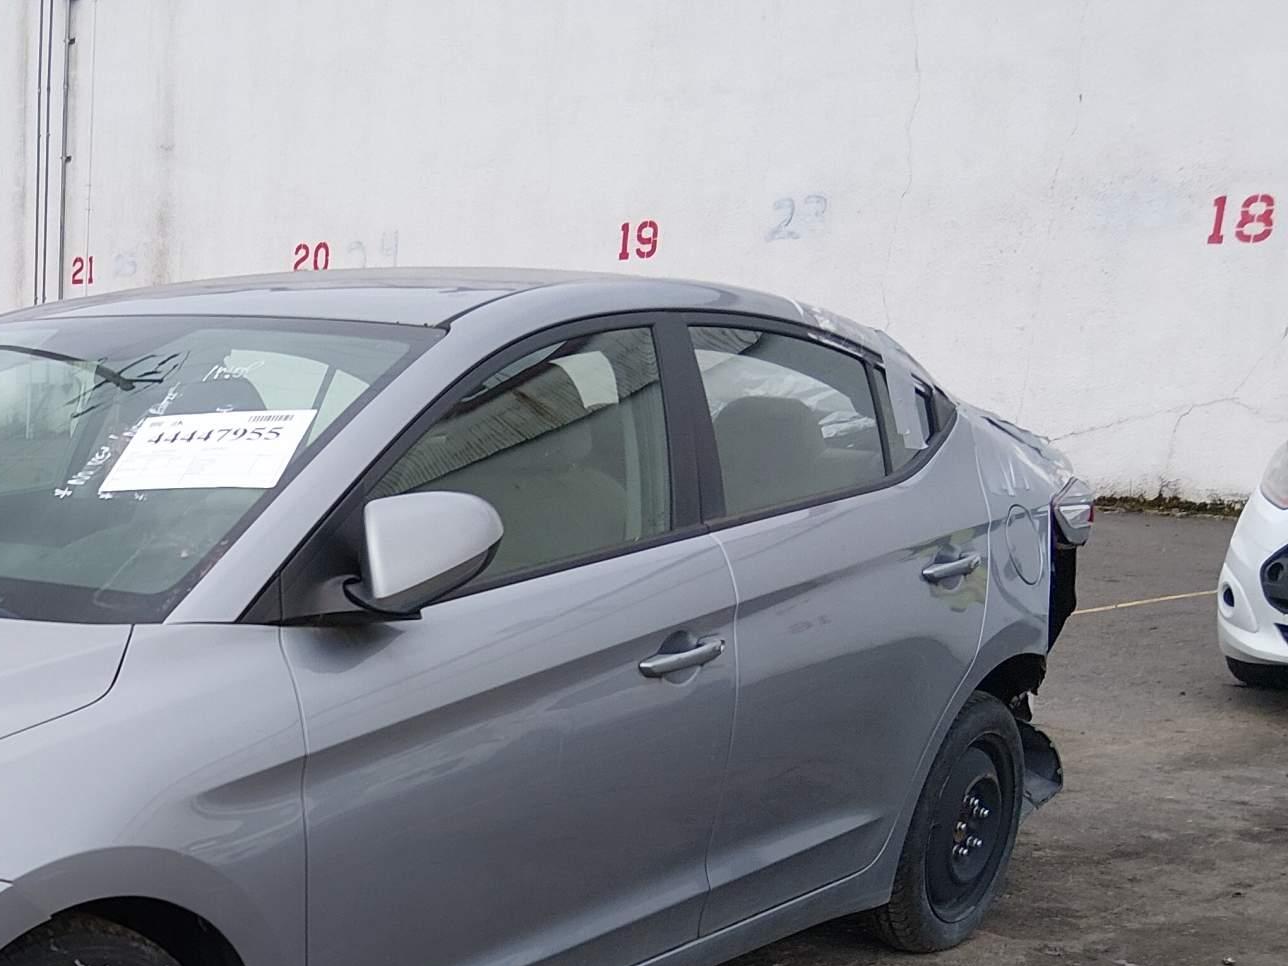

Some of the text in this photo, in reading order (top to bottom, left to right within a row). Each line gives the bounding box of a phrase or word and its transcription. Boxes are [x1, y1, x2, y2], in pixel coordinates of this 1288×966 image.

[1207, 194, 1275, 245] 18
[618, 219, 659, 261] 19
[71, 256, 94, 286] 21
[293, 241, 330, 272] 20
[147, 426, 284, 444] 44447955
